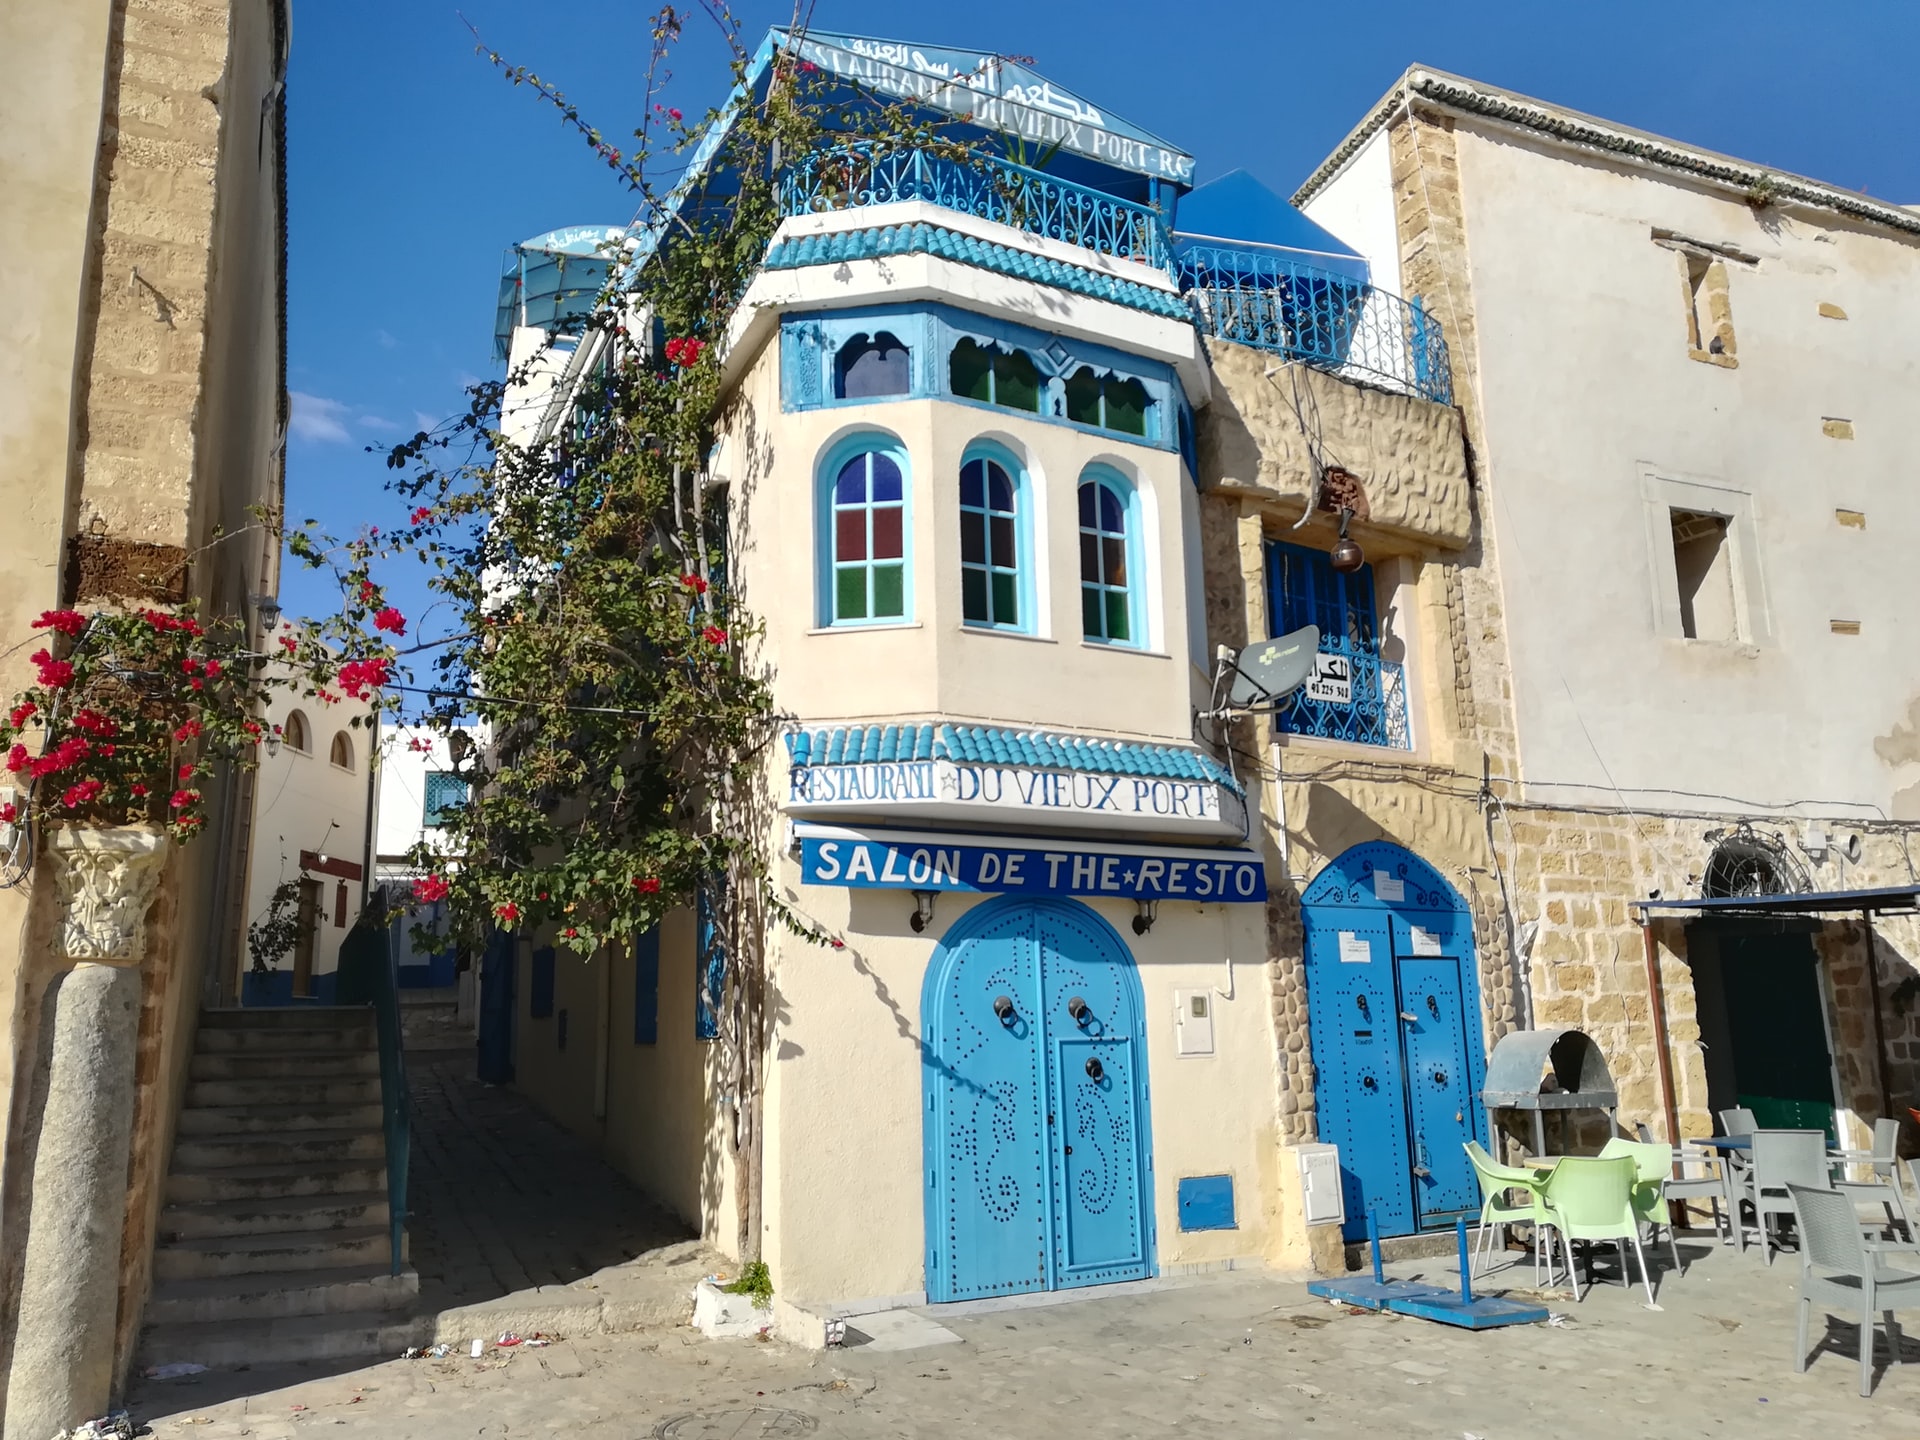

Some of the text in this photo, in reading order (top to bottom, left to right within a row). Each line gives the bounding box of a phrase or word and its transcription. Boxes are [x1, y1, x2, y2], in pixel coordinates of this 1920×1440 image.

[972, 92, 1005, 125] DU
[1011, 102, 1082, 149] VIEUX
[1309, 660, 1348, 683] للكرا
[790, 762, 1212, 817] RESTAURANT DU VIEUX PORT
[815, 842, 1257, 897] SALON DE THE RESTO
